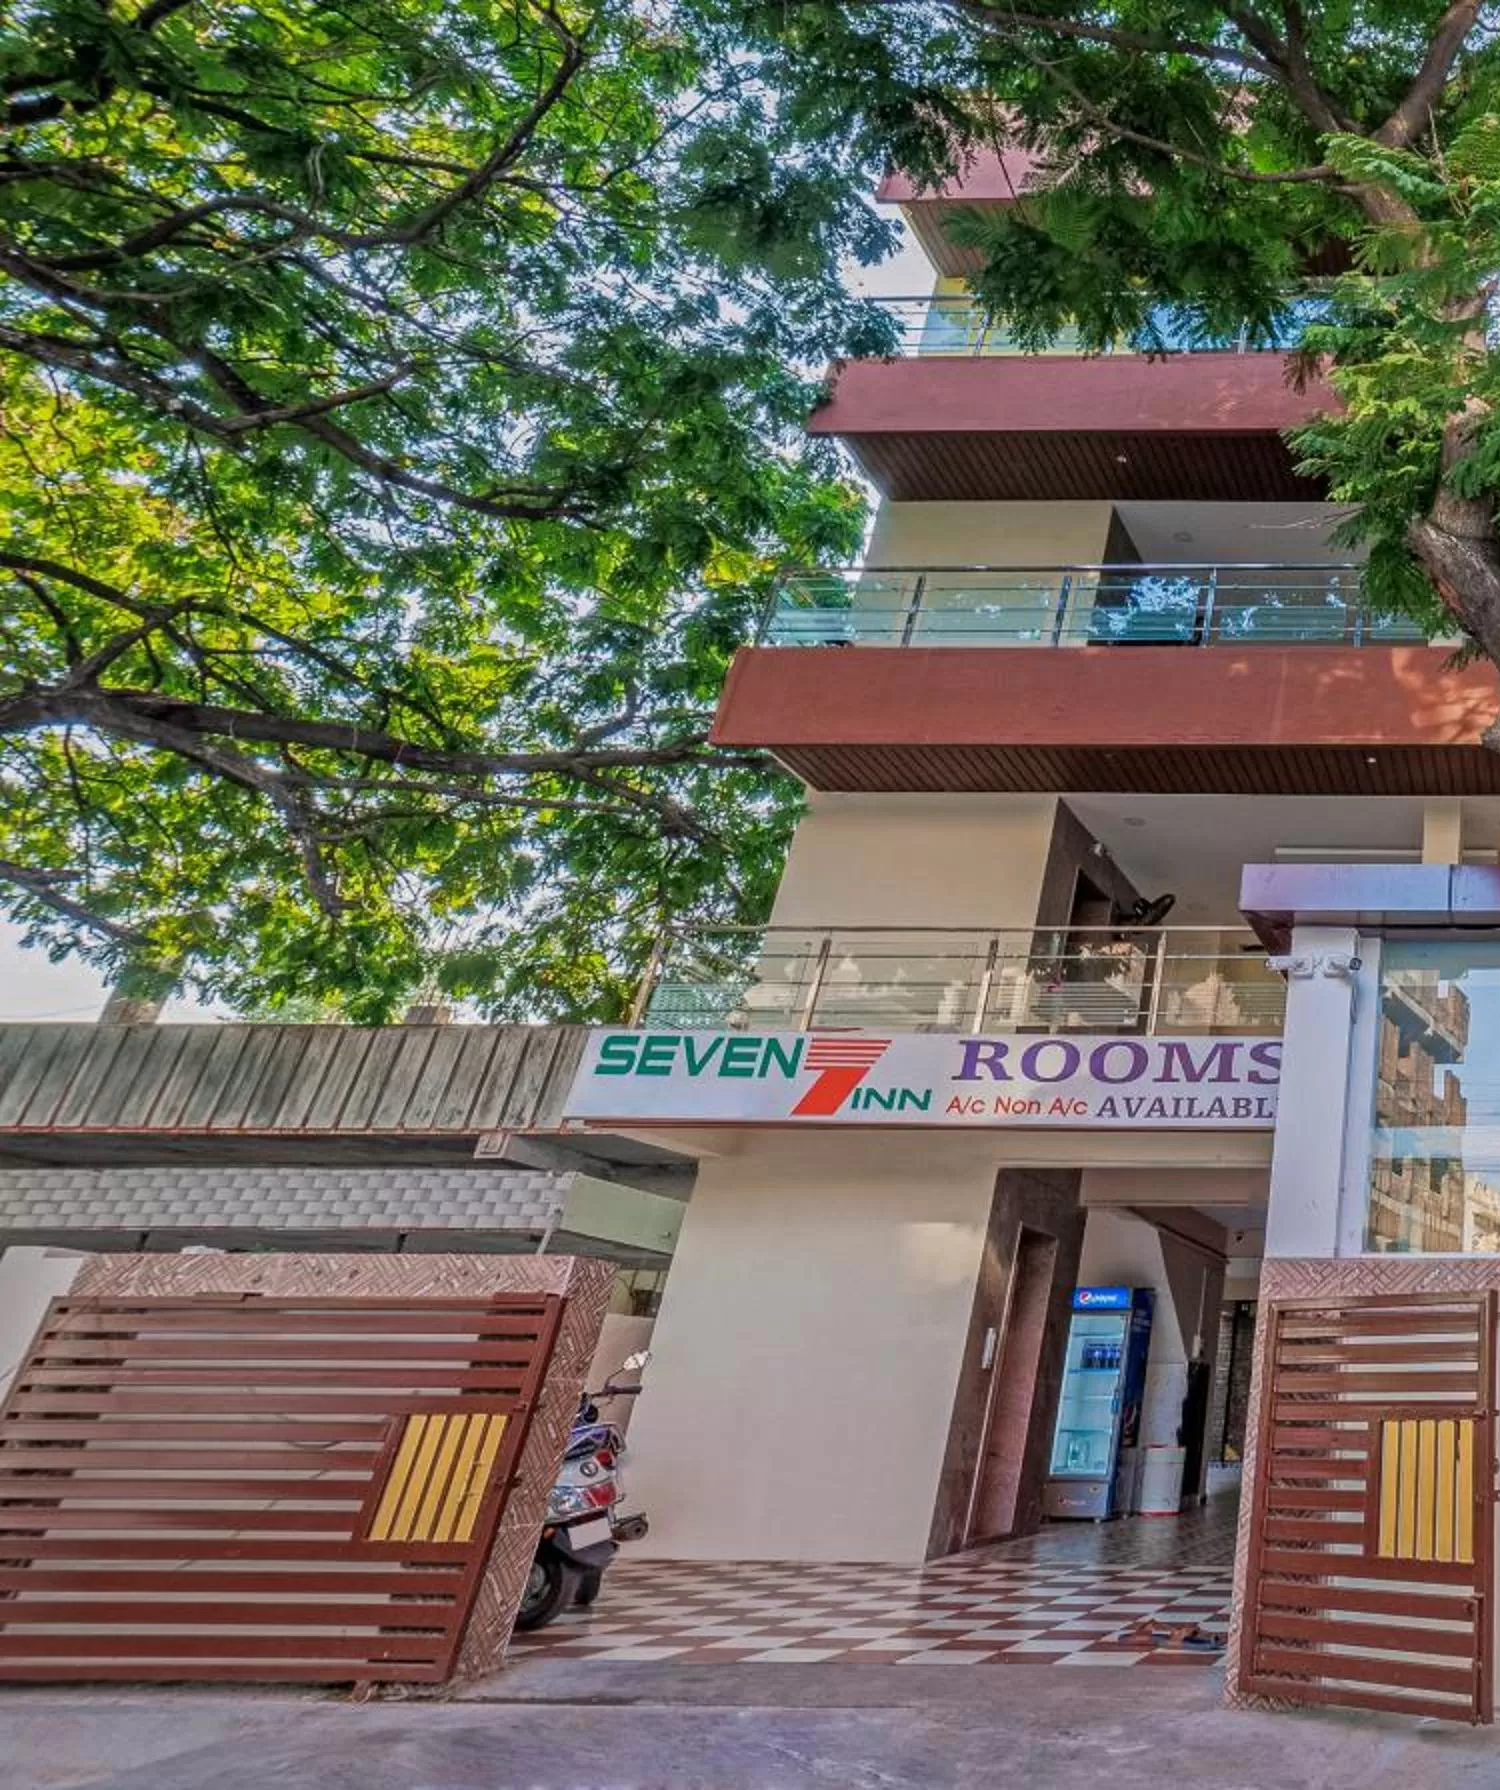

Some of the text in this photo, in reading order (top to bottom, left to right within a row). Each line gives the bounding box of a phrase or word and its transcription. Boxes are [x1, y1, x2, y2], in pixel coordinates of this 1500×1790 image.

[594, 1035, 804, 1078] SEVEN
[851, 1087, 933, 1111] INN
[951, 1039, 1282, 1084] ROOMS
[993, 1096, 1041, 1115] Non
[1096, 1096, 1279, 1119] AVAILABL
